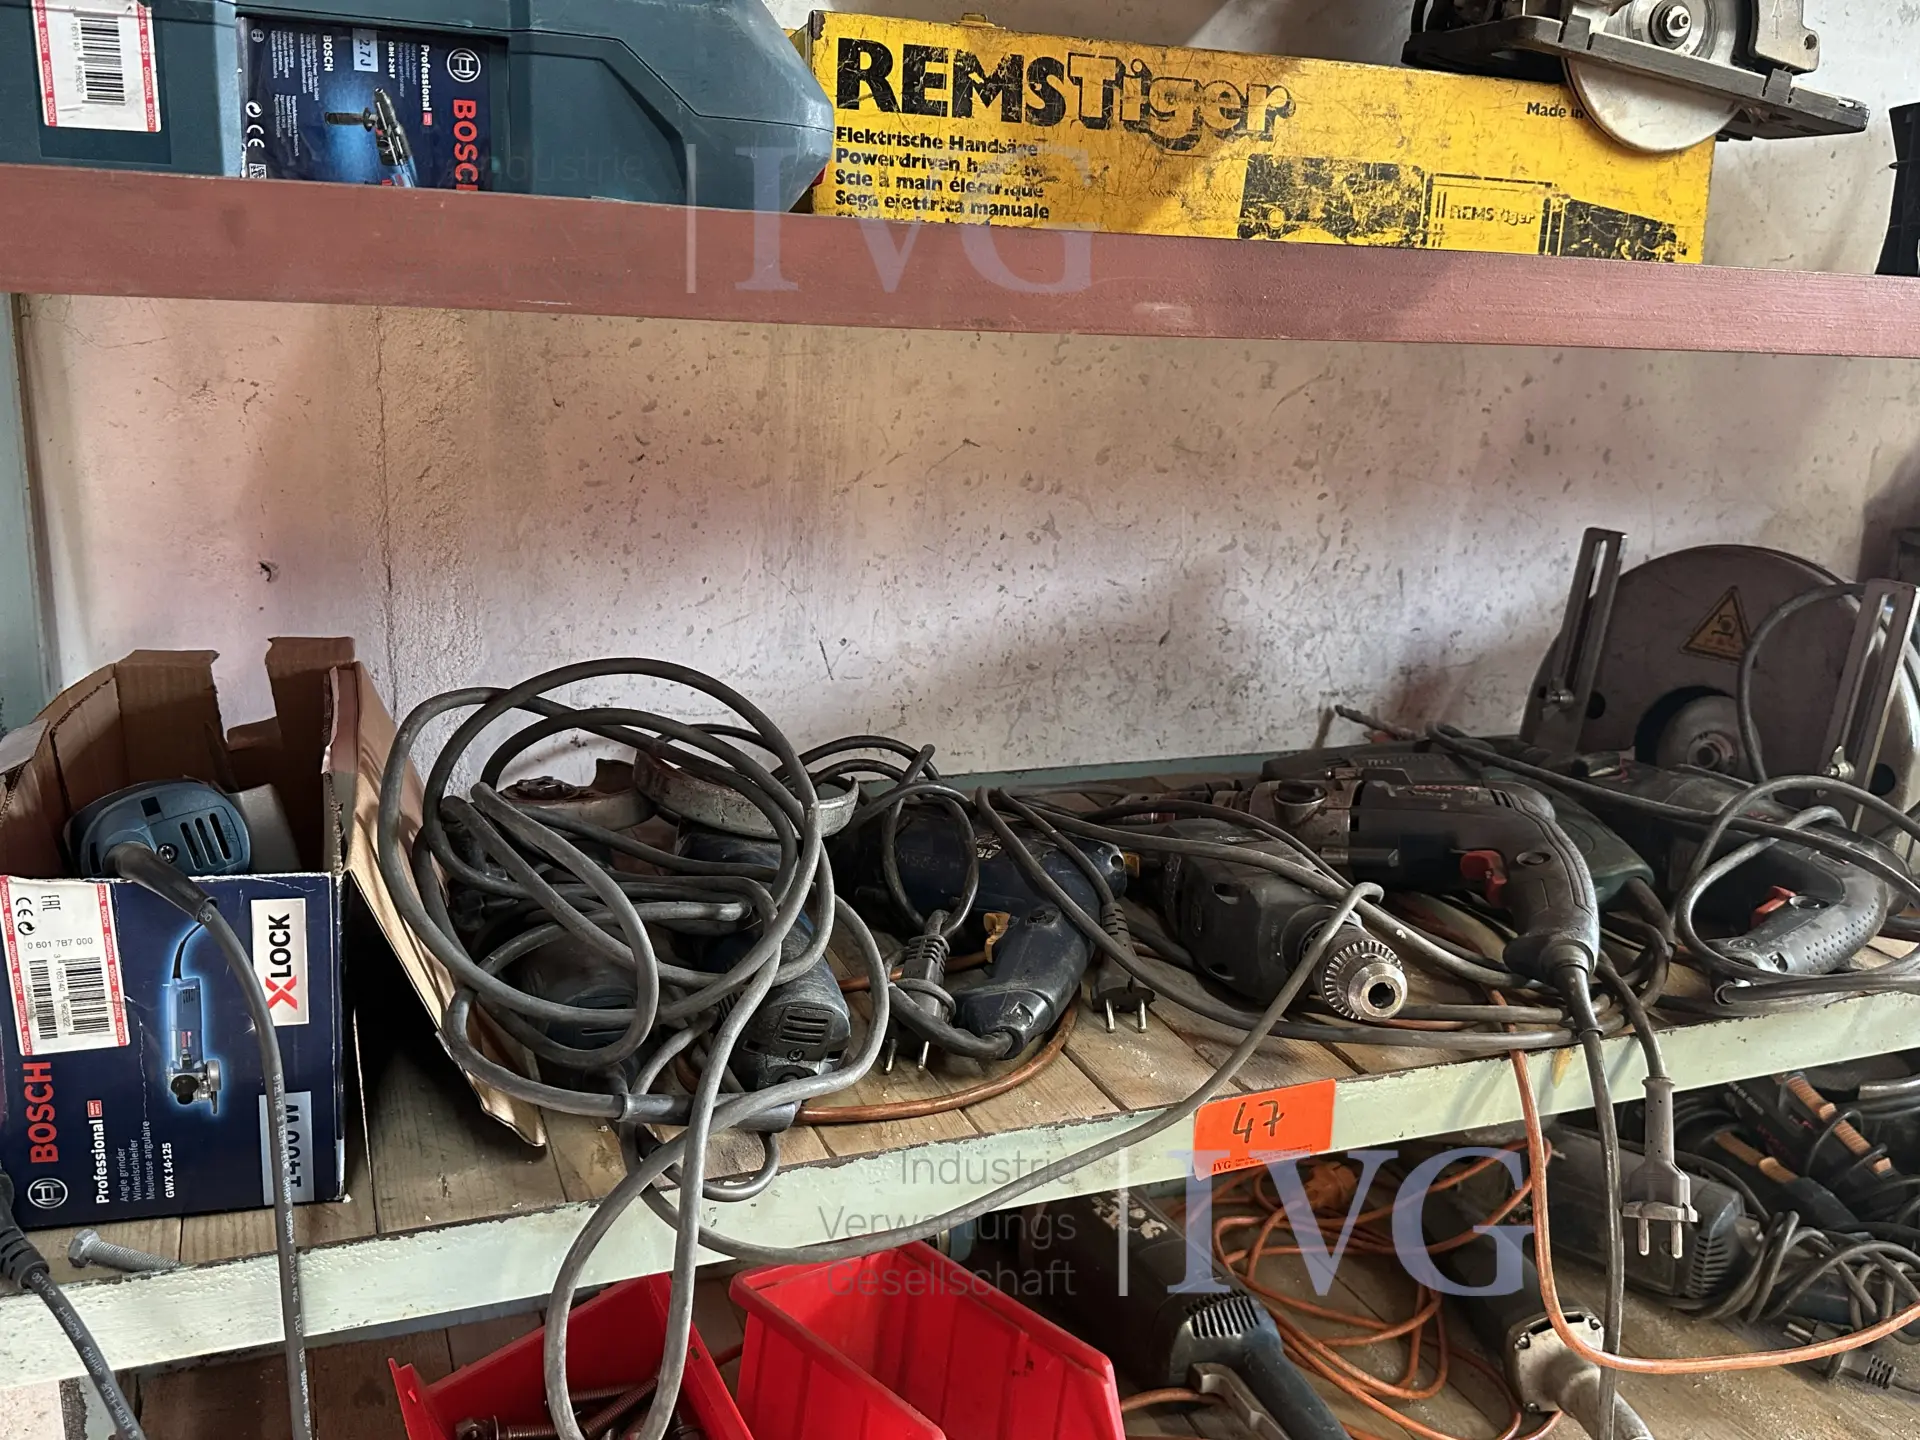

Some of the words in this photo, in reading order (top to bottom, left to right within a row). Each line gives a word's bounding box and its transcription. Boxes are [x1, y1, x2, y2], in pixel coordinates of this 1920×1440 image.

[39, 27, 48, 54] BOSCH
[140, 34, 149, 60] BOSCH
[323, 35, 334, 72] BOSCH
[359, 39, 371, 58] 2.7
[43, 60, 52, 93] ORIGINAL
[143, 67, 153, 100] ORIGINAL
[421, 44, 432, 112] Professional
[47, 98, 56, 123] BOSCH
[146, 103, 156, 129] BOSCH
[1526, 102, 1567, 118] Made
[1571, 108, 1584, 119] in
[836, 126, 943, 151] Elektrische
[836, 168, 873, 187] Scie
[896, 173, 943, 192] main
[836, 190, 878, 211] Sega
[971, 202, 1049, 219] manuale
[5, 913, 14, 935] BOSCH
[101, 905, 109, 928] BOSCH
[8, 941, 19, 970] ORIGINAL
[27, 942, 33, 950] 0
[36, 940, 52, 949] 601
[56, 938, 73, 949] 7B7
[76, 937, 93, 946] 000
[104, 933, 115, 962] ORIGINAL
[13, 972, 22, 995] BOSCH
[55, 967, 66, 992] 165140
[108, 964, 117, 986] BOSCH
[17, 1000, 28, 1029] ORIGINAL
[22, 1031, 31, 1052] BOSCH
[115, 1021, 124, 1044] BOSCH
[22, 1062, 59, 1163] BOSCH
[1232, 1100, 1285, 1144] 47
[141, 1120, 155, 1160] angulaire
[88, 1119, 110, 1204] Professional
[116, 1147, 129, 1174] grinder
[129, 1139, 142, 1201] Winkelschleifer
[162, 1142, 174, 1173] 14-125
[1213, 1160, 1232, 1172] IVG
[119, 1175, 130, 1203] Angle
[145, 1160, 155, 1201] Meuleuse
[163, 1174, 175, 1199] GWX
